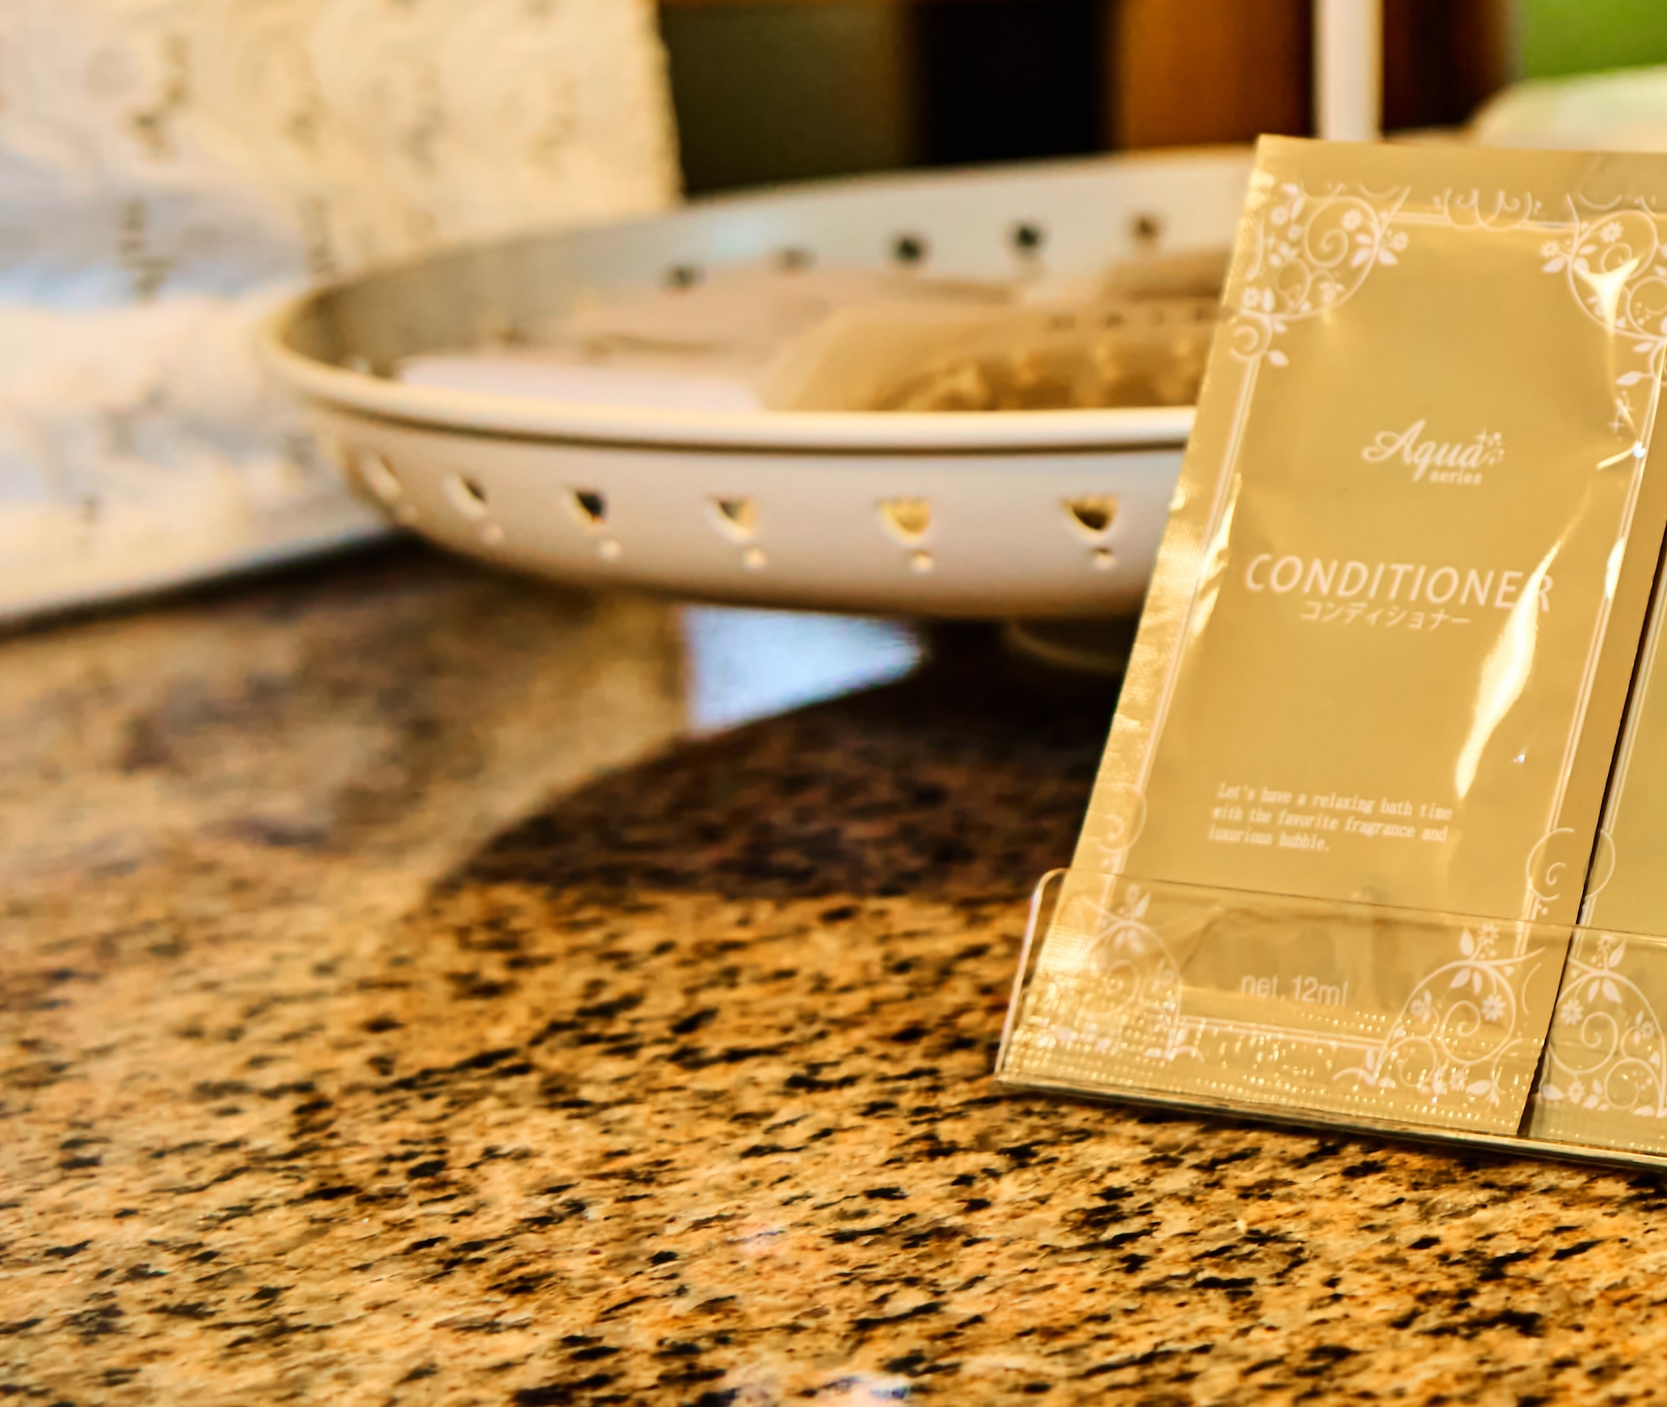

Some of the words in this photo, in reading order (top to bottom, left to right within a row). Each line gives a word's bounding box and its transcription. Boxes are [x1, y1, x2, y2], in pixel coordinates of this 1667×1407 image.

[1361, 419, 1490, 482] Aqua
[1429, 466, 1482, 485] series
[1244, 553, 1555, 613] CONDITIONER
[1300, 600, 1471, 631] コンディショナー
